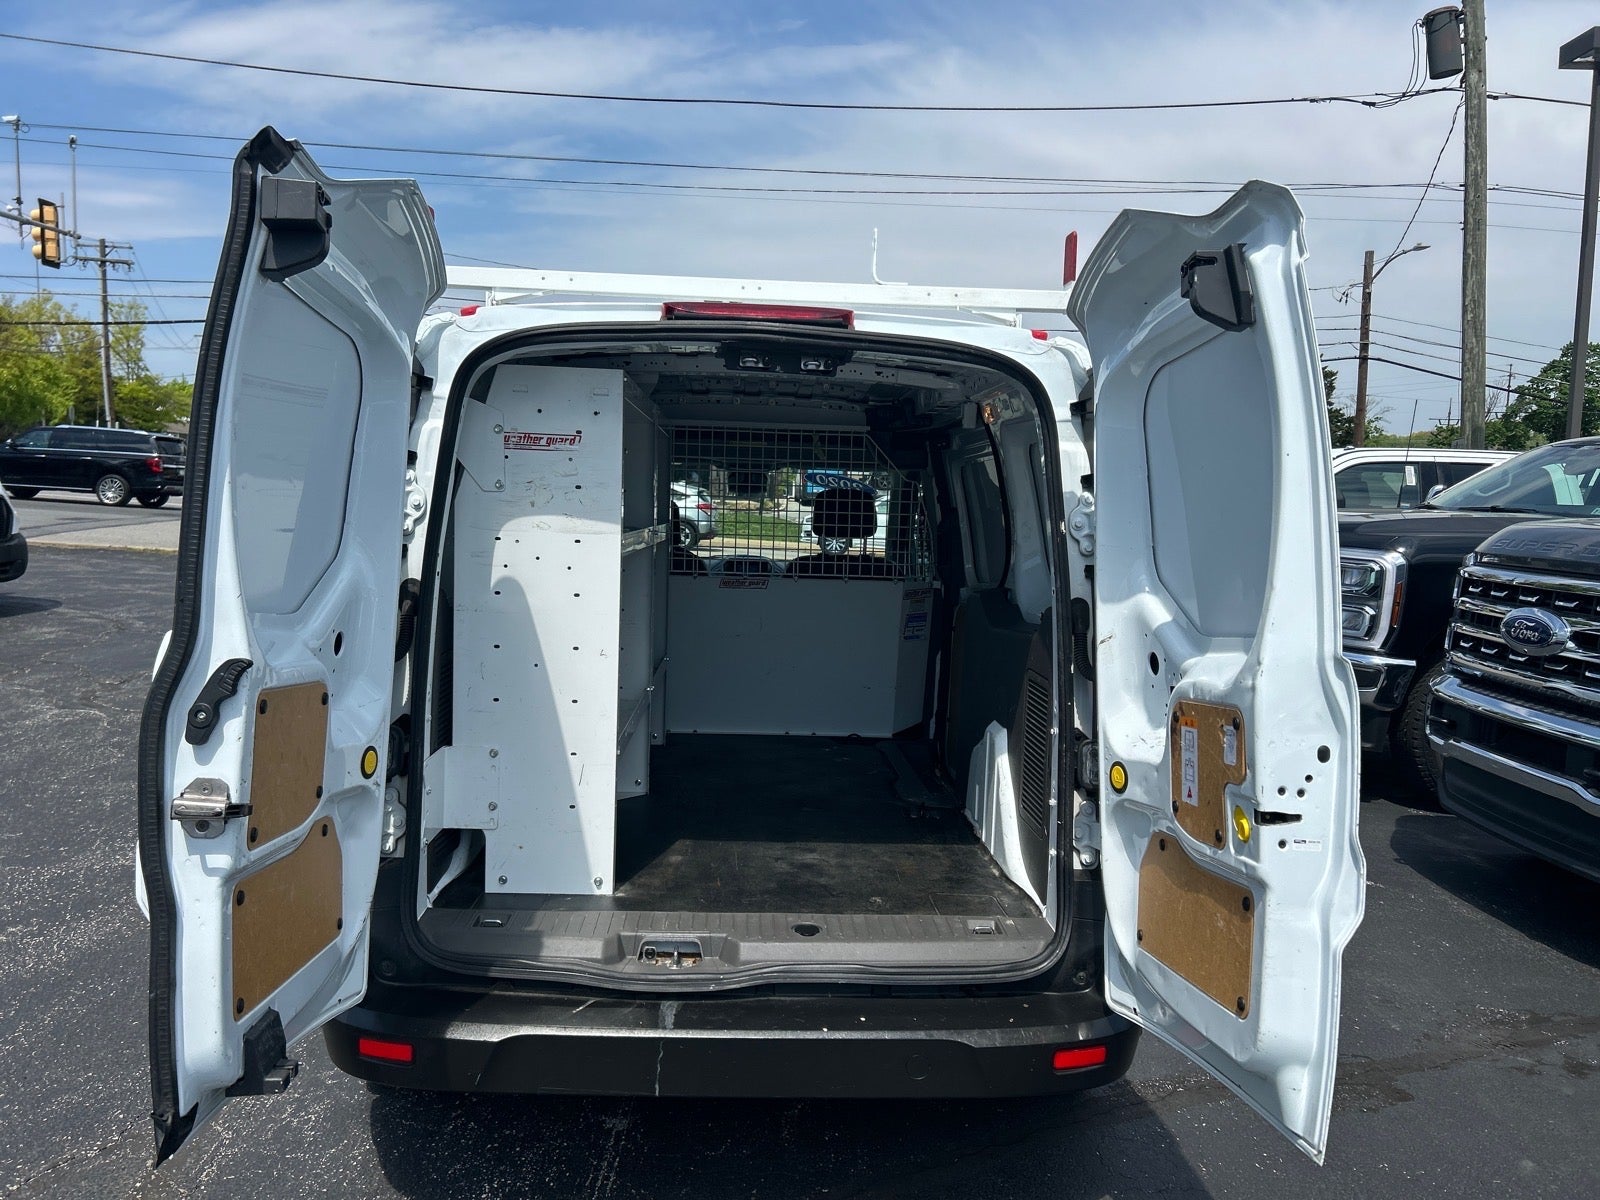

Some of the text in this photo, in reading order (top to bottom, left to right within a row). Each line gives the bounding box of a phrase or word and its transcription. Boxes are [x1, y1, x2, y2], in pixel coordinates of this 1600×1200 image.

[545, 436, 577, 447] guard
[1491, 538, 1578, 554] SUPER
[1510, 619, 1542, 642] Ford
